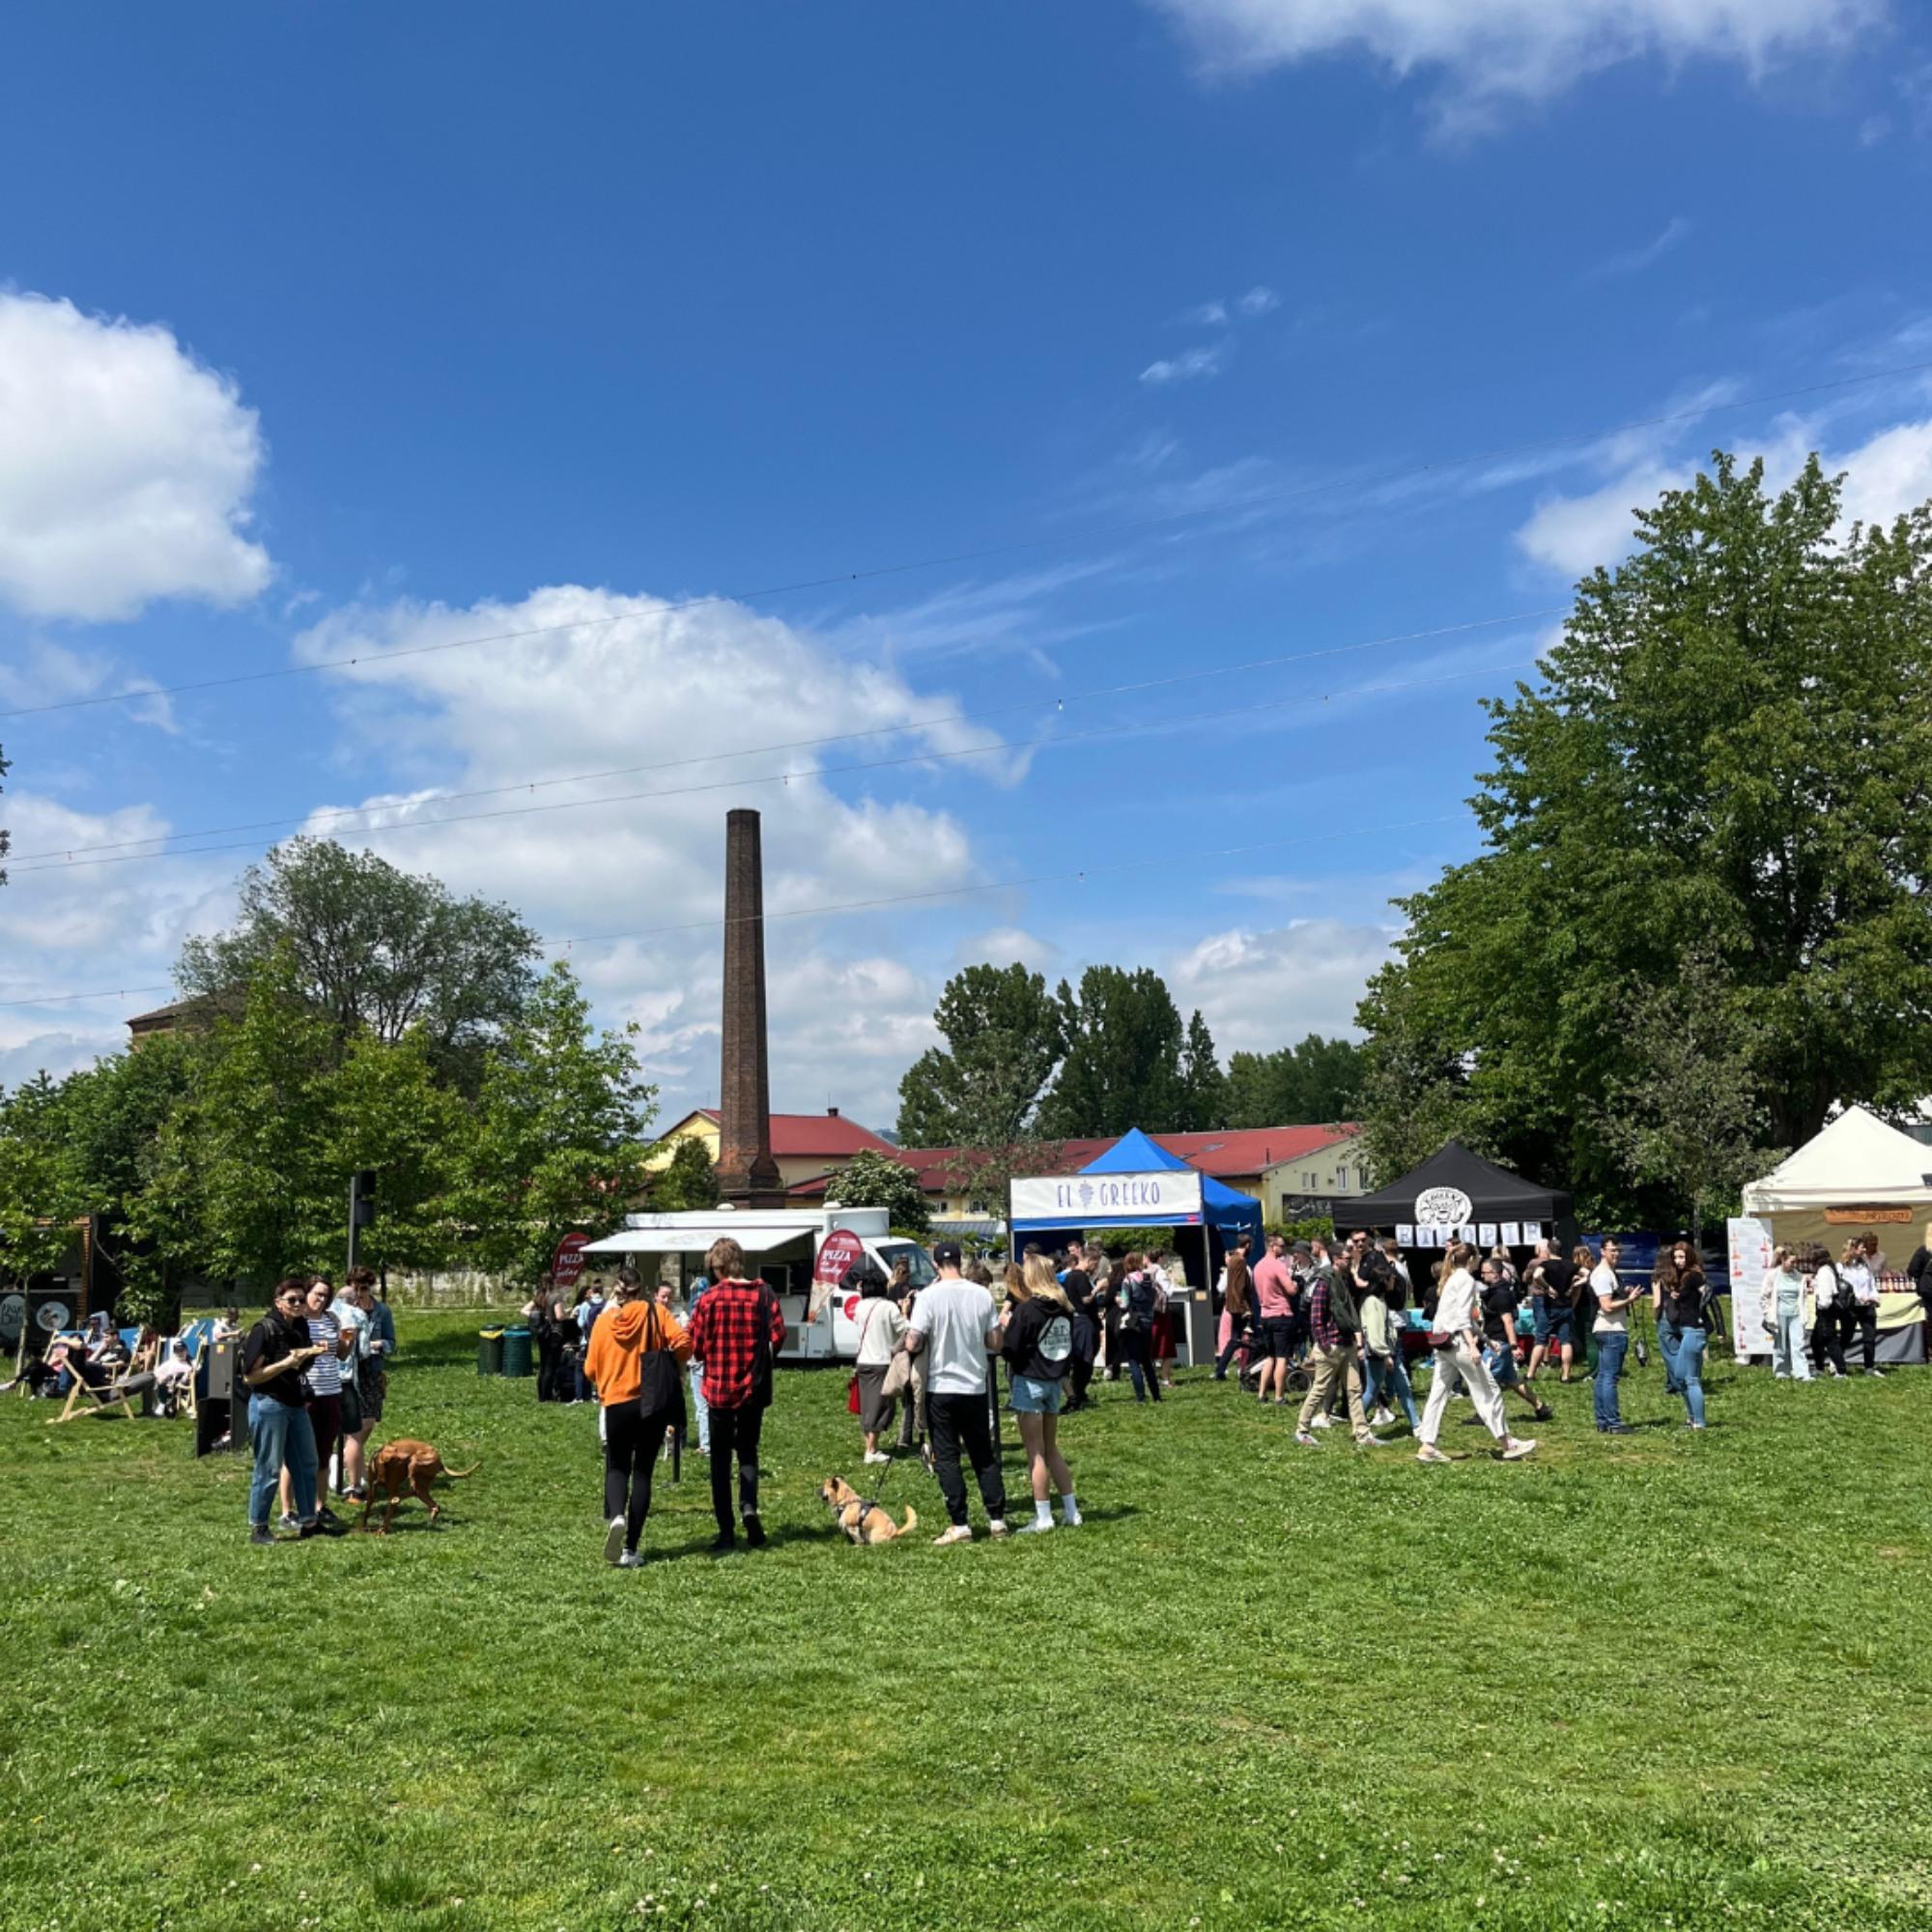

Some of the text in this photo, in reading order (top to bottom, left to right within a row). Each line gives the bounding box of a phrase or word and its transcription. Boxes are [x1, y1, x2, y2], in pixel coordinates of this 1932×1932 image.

[1057, 1181, 1160, 1208] EL GREEKO
[822, 1249, 851, 1262] PIZZA
